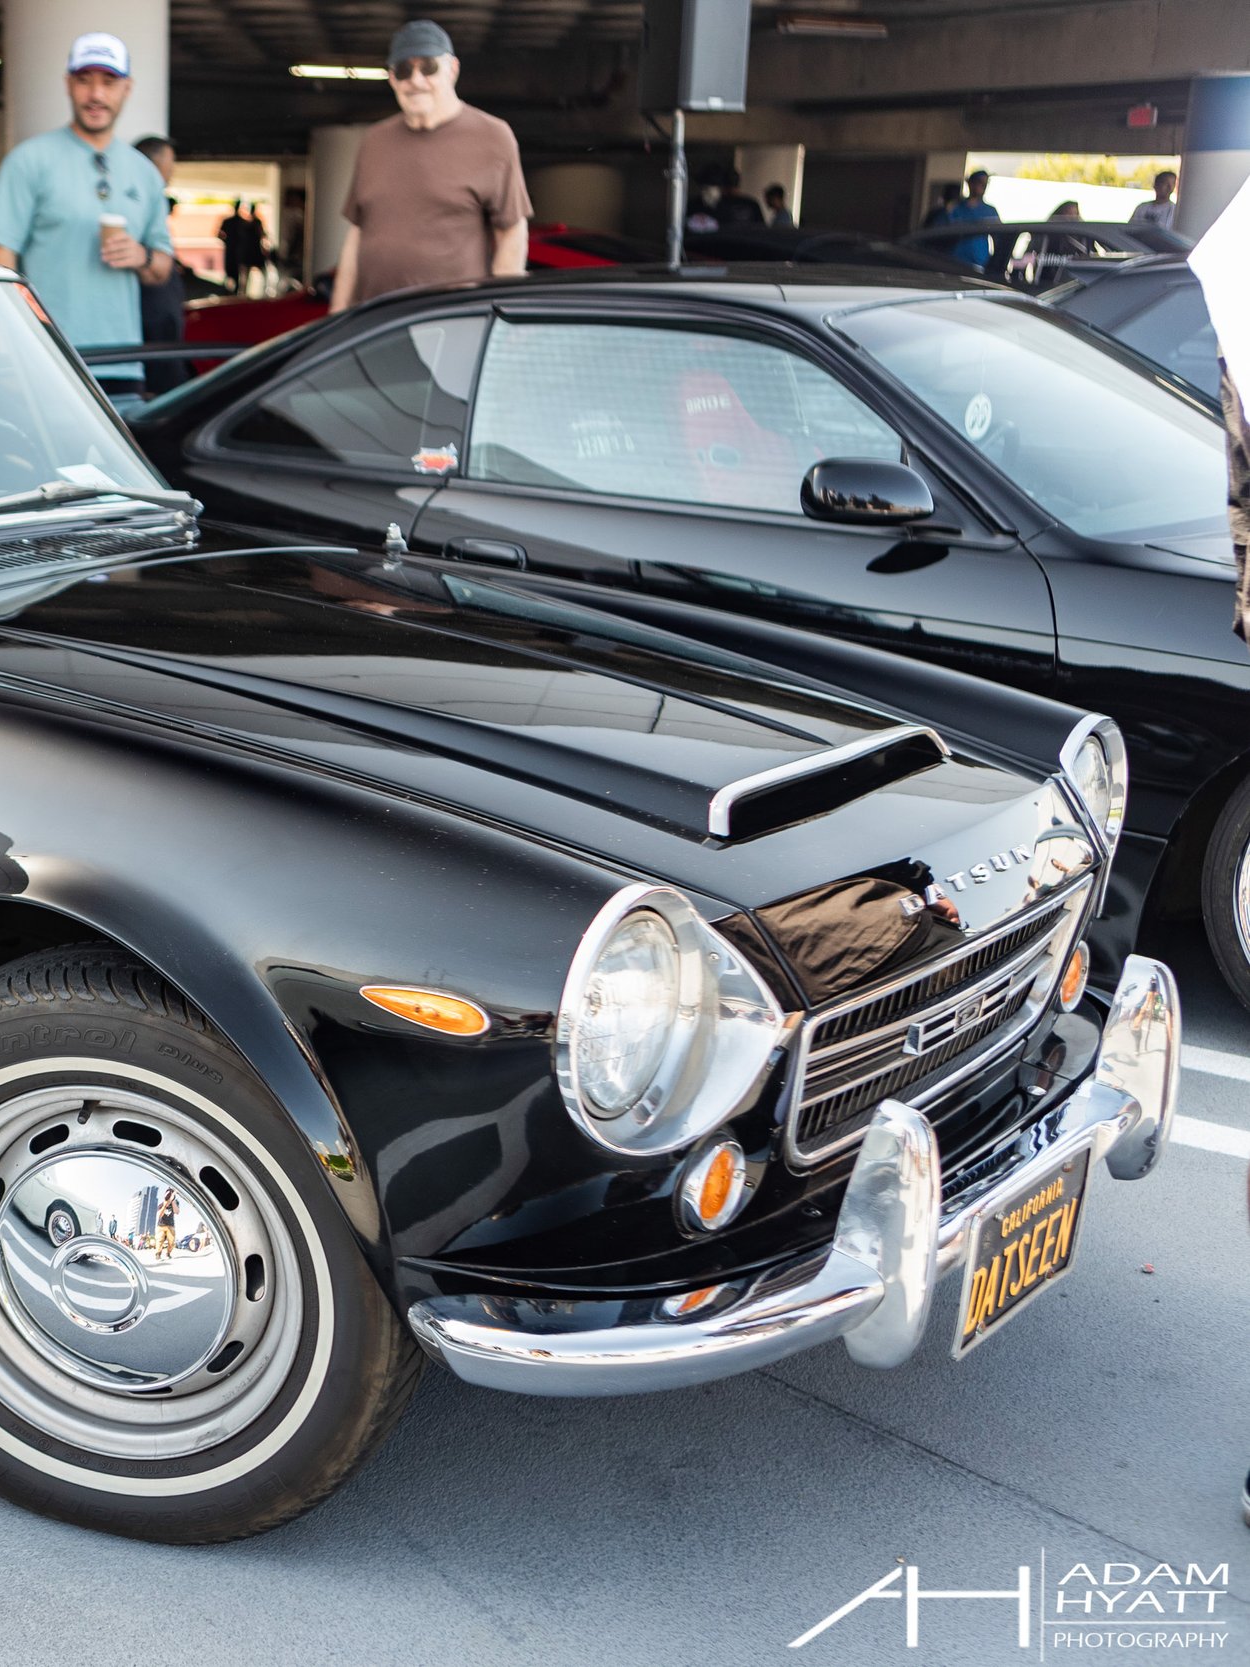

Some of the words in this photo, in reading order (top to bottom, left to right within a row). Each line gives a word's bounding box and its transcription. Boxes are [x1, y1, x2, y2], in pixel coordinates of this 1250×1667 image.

[900, 844, 1032, 916] DATSUN
[1001, 1176, 1063, 1238] CALIFORNIA
[963, 1197, 1077, 1336] DATSEEN
